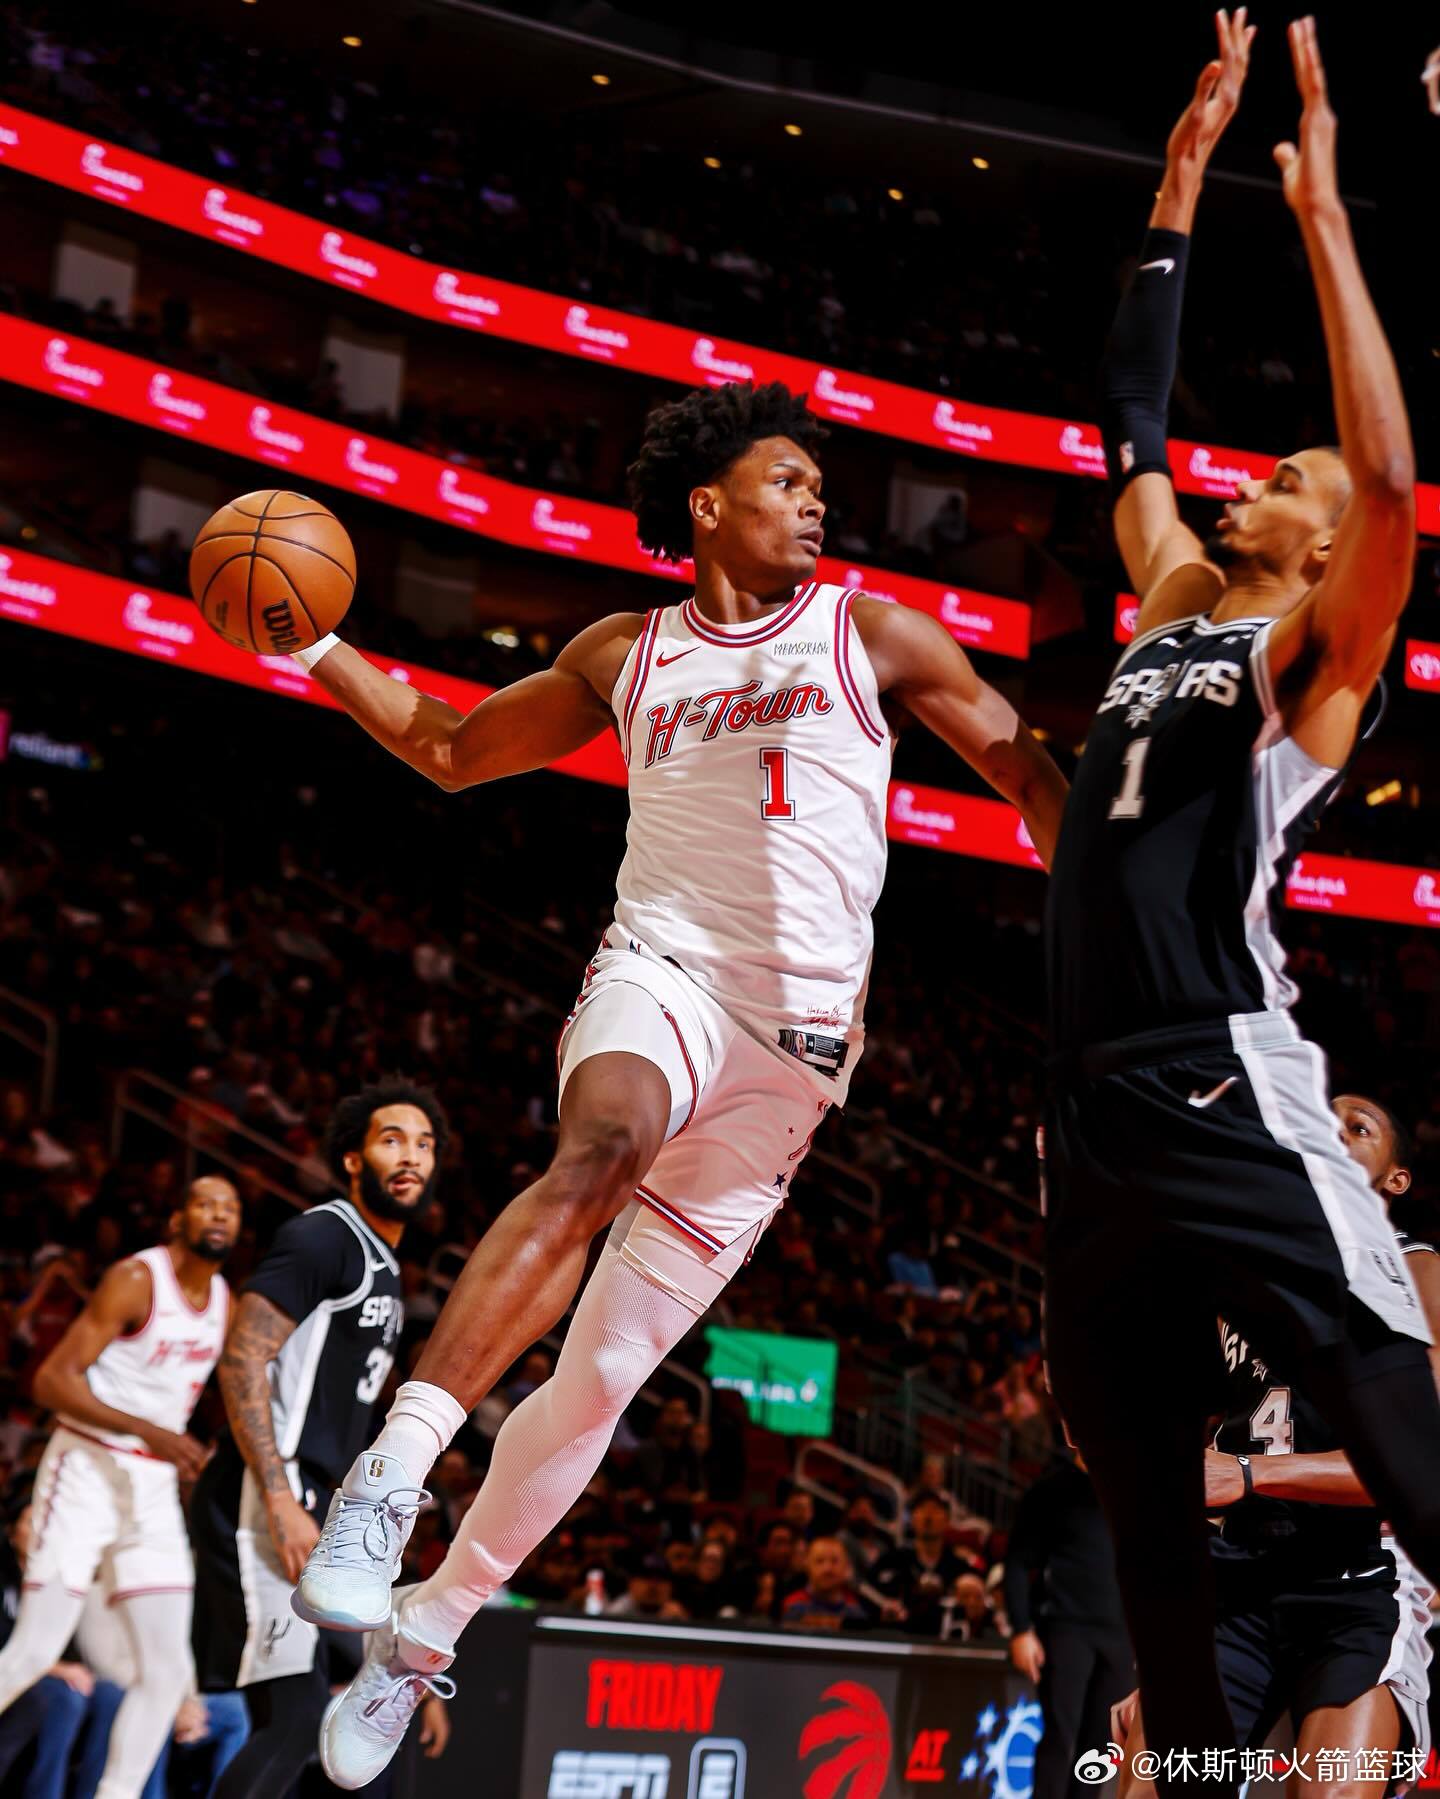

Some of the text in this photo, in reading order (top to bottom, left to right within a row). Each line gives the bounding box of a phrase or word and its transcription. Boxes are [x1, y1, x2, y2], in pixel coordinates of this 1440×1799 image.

[645, 680, 834, 768] H-Town
[759, 747, 796, 821] 1
[1108, 737, 1151, 820] 1
[1250, 1387, 1294, 1455] 4
[586, 1659, 724, 1733] FRIDAY
[548, 1751, 671, 1799] ESPN
[905, 1729, 950, 1773] AT
